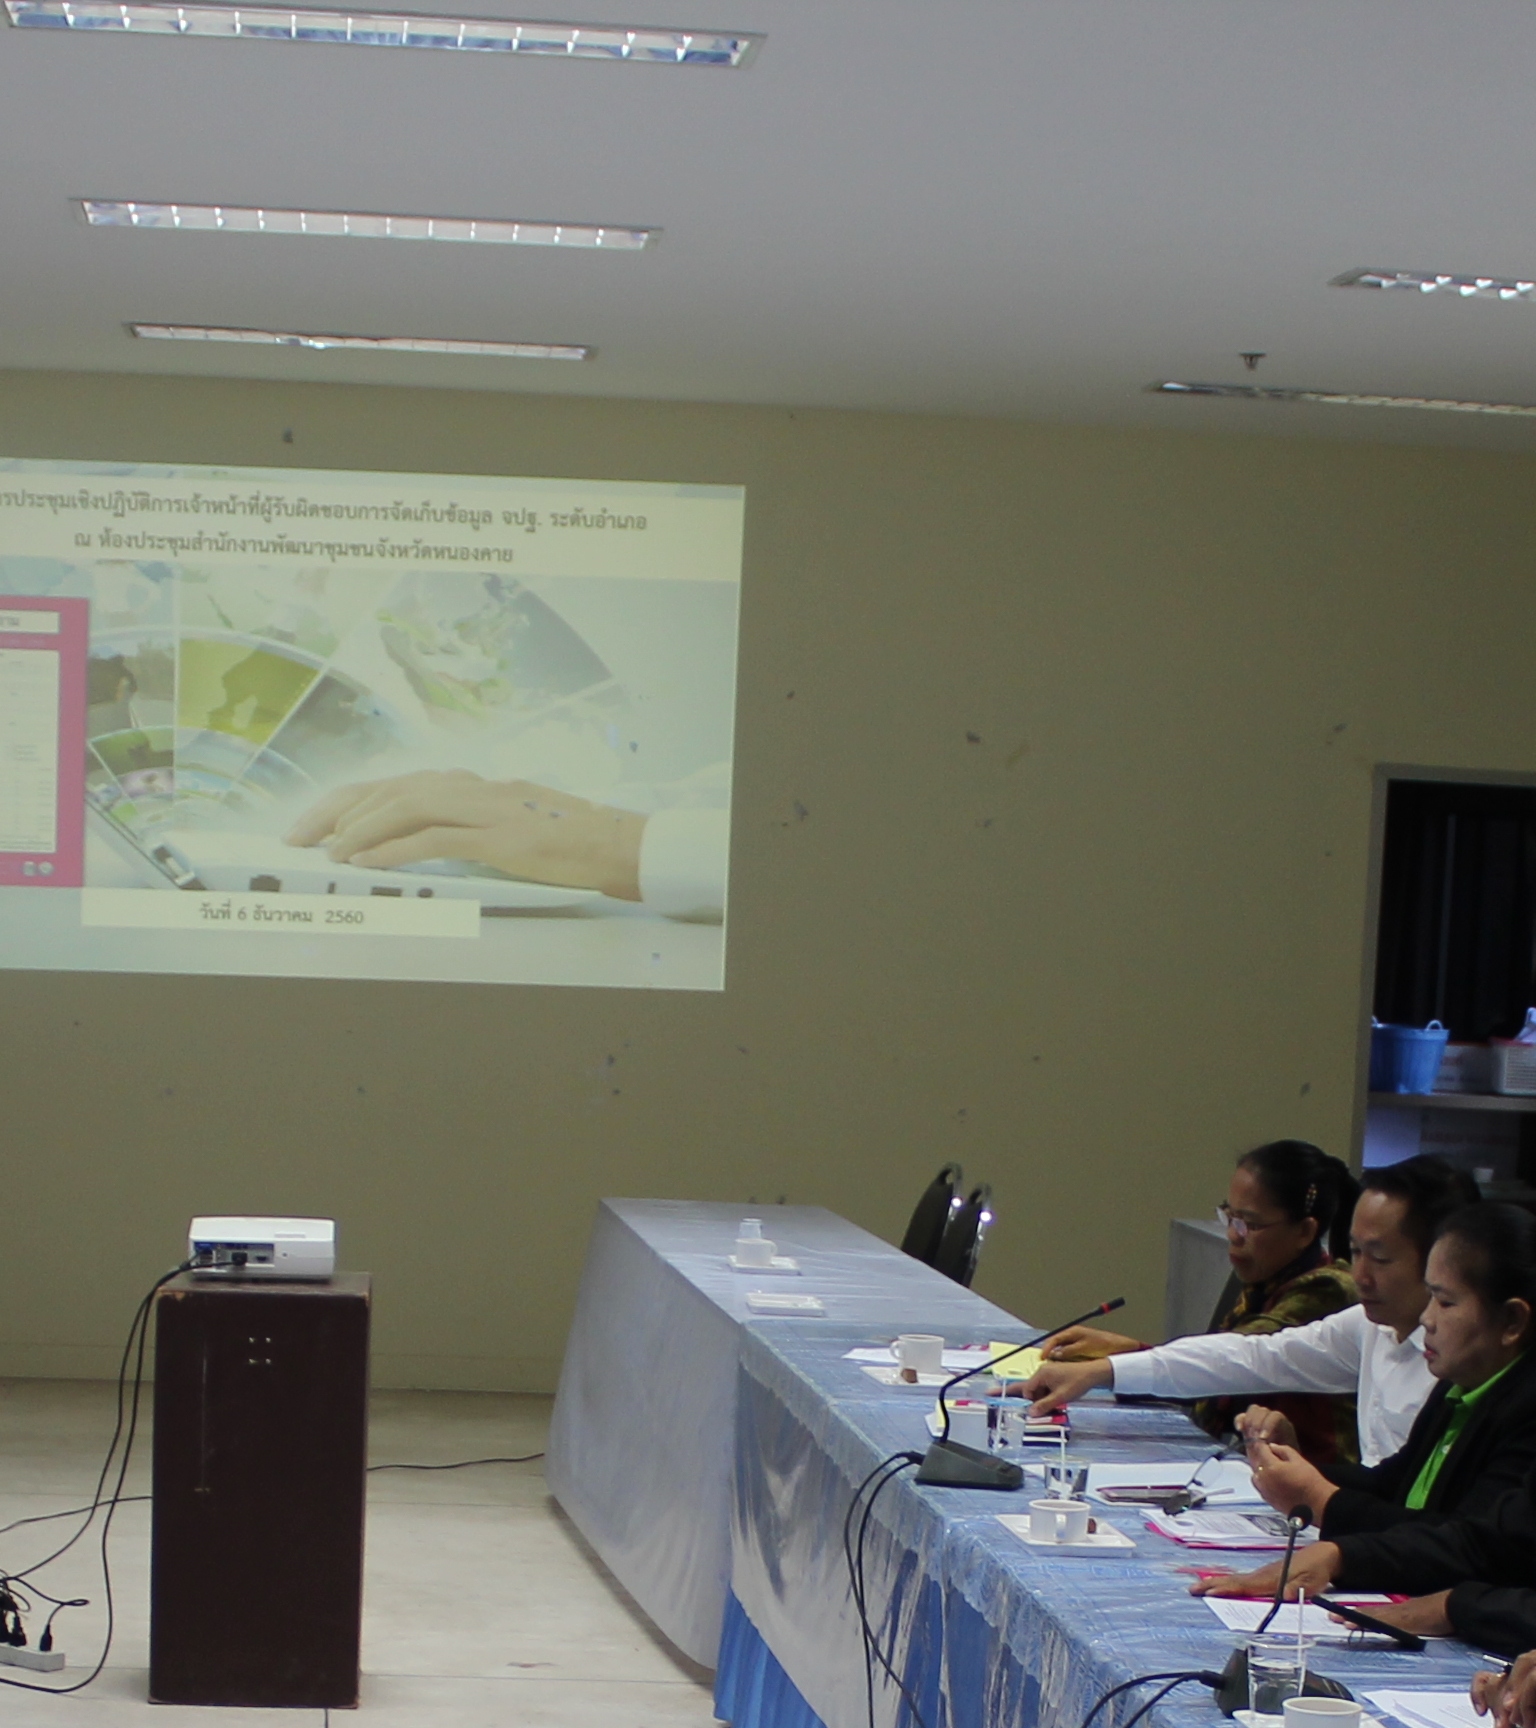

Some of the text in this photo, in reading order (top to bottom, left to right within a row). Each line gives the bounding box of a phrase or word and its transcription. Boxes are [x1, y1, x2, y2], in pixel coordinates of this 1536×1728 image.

[501, 508, 542, 533] จปฐ.
[549, 506, 648, 530] ระดับอำเภอ
[199, 898, 364, 924] วันที่ 6 ธันวาคม 2560
